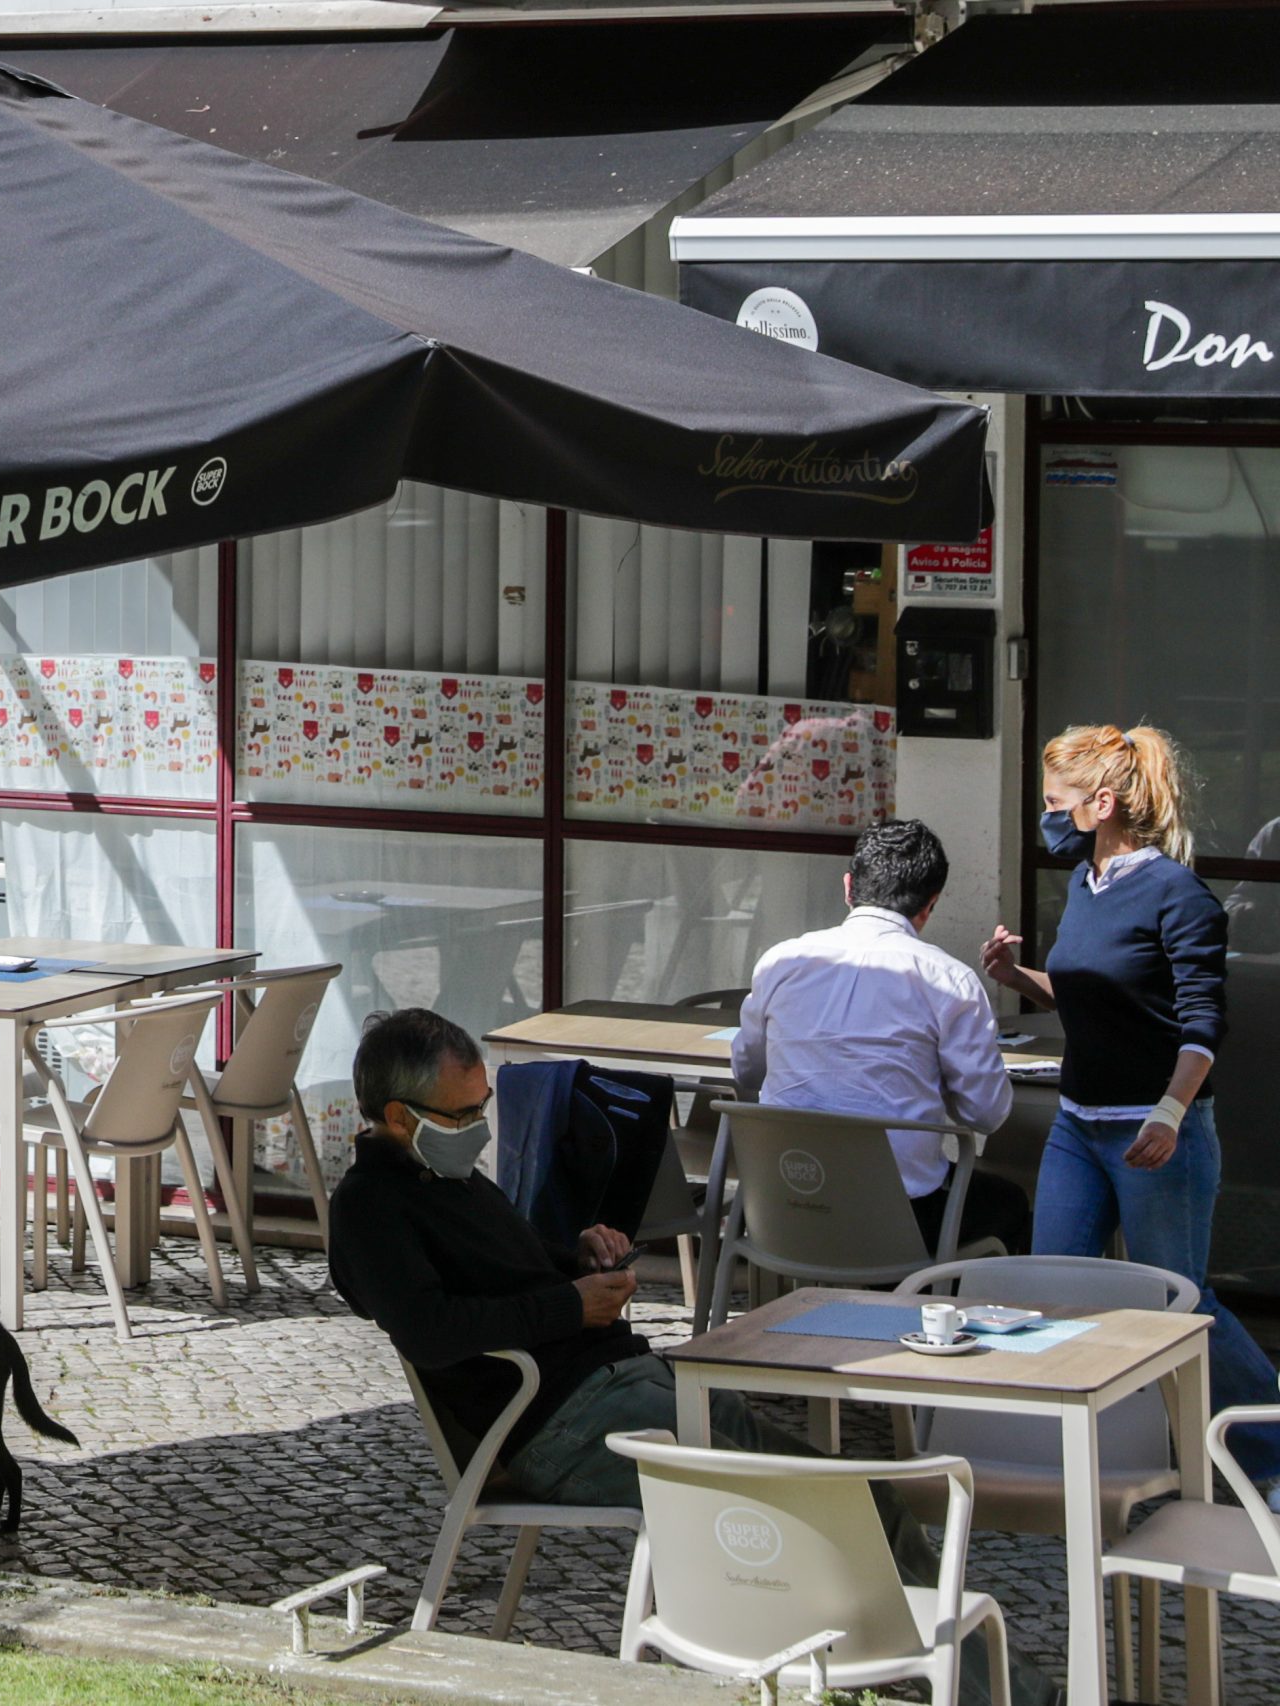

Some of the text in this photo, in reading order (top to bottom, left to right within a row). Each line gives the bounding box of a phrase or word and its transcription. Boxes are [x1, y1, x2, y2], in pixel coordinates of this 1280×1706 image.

[1143, 300, 1274, 371] Don
[697, 433, 778, 480] Sabor
[199, 468, 223, 481] SUPER
[196, 479, 219, 493] BOCK
[38, 466, 178, 542] BOCK
[947, 545, 987, 556] imagens
[911, 556, 940, 567] Aviso
[933, 575, 992, 585] Securitas Direct
[721, 1521, 771, 1538] SUPER
[727, 1535, 773, 1551] BOCK
